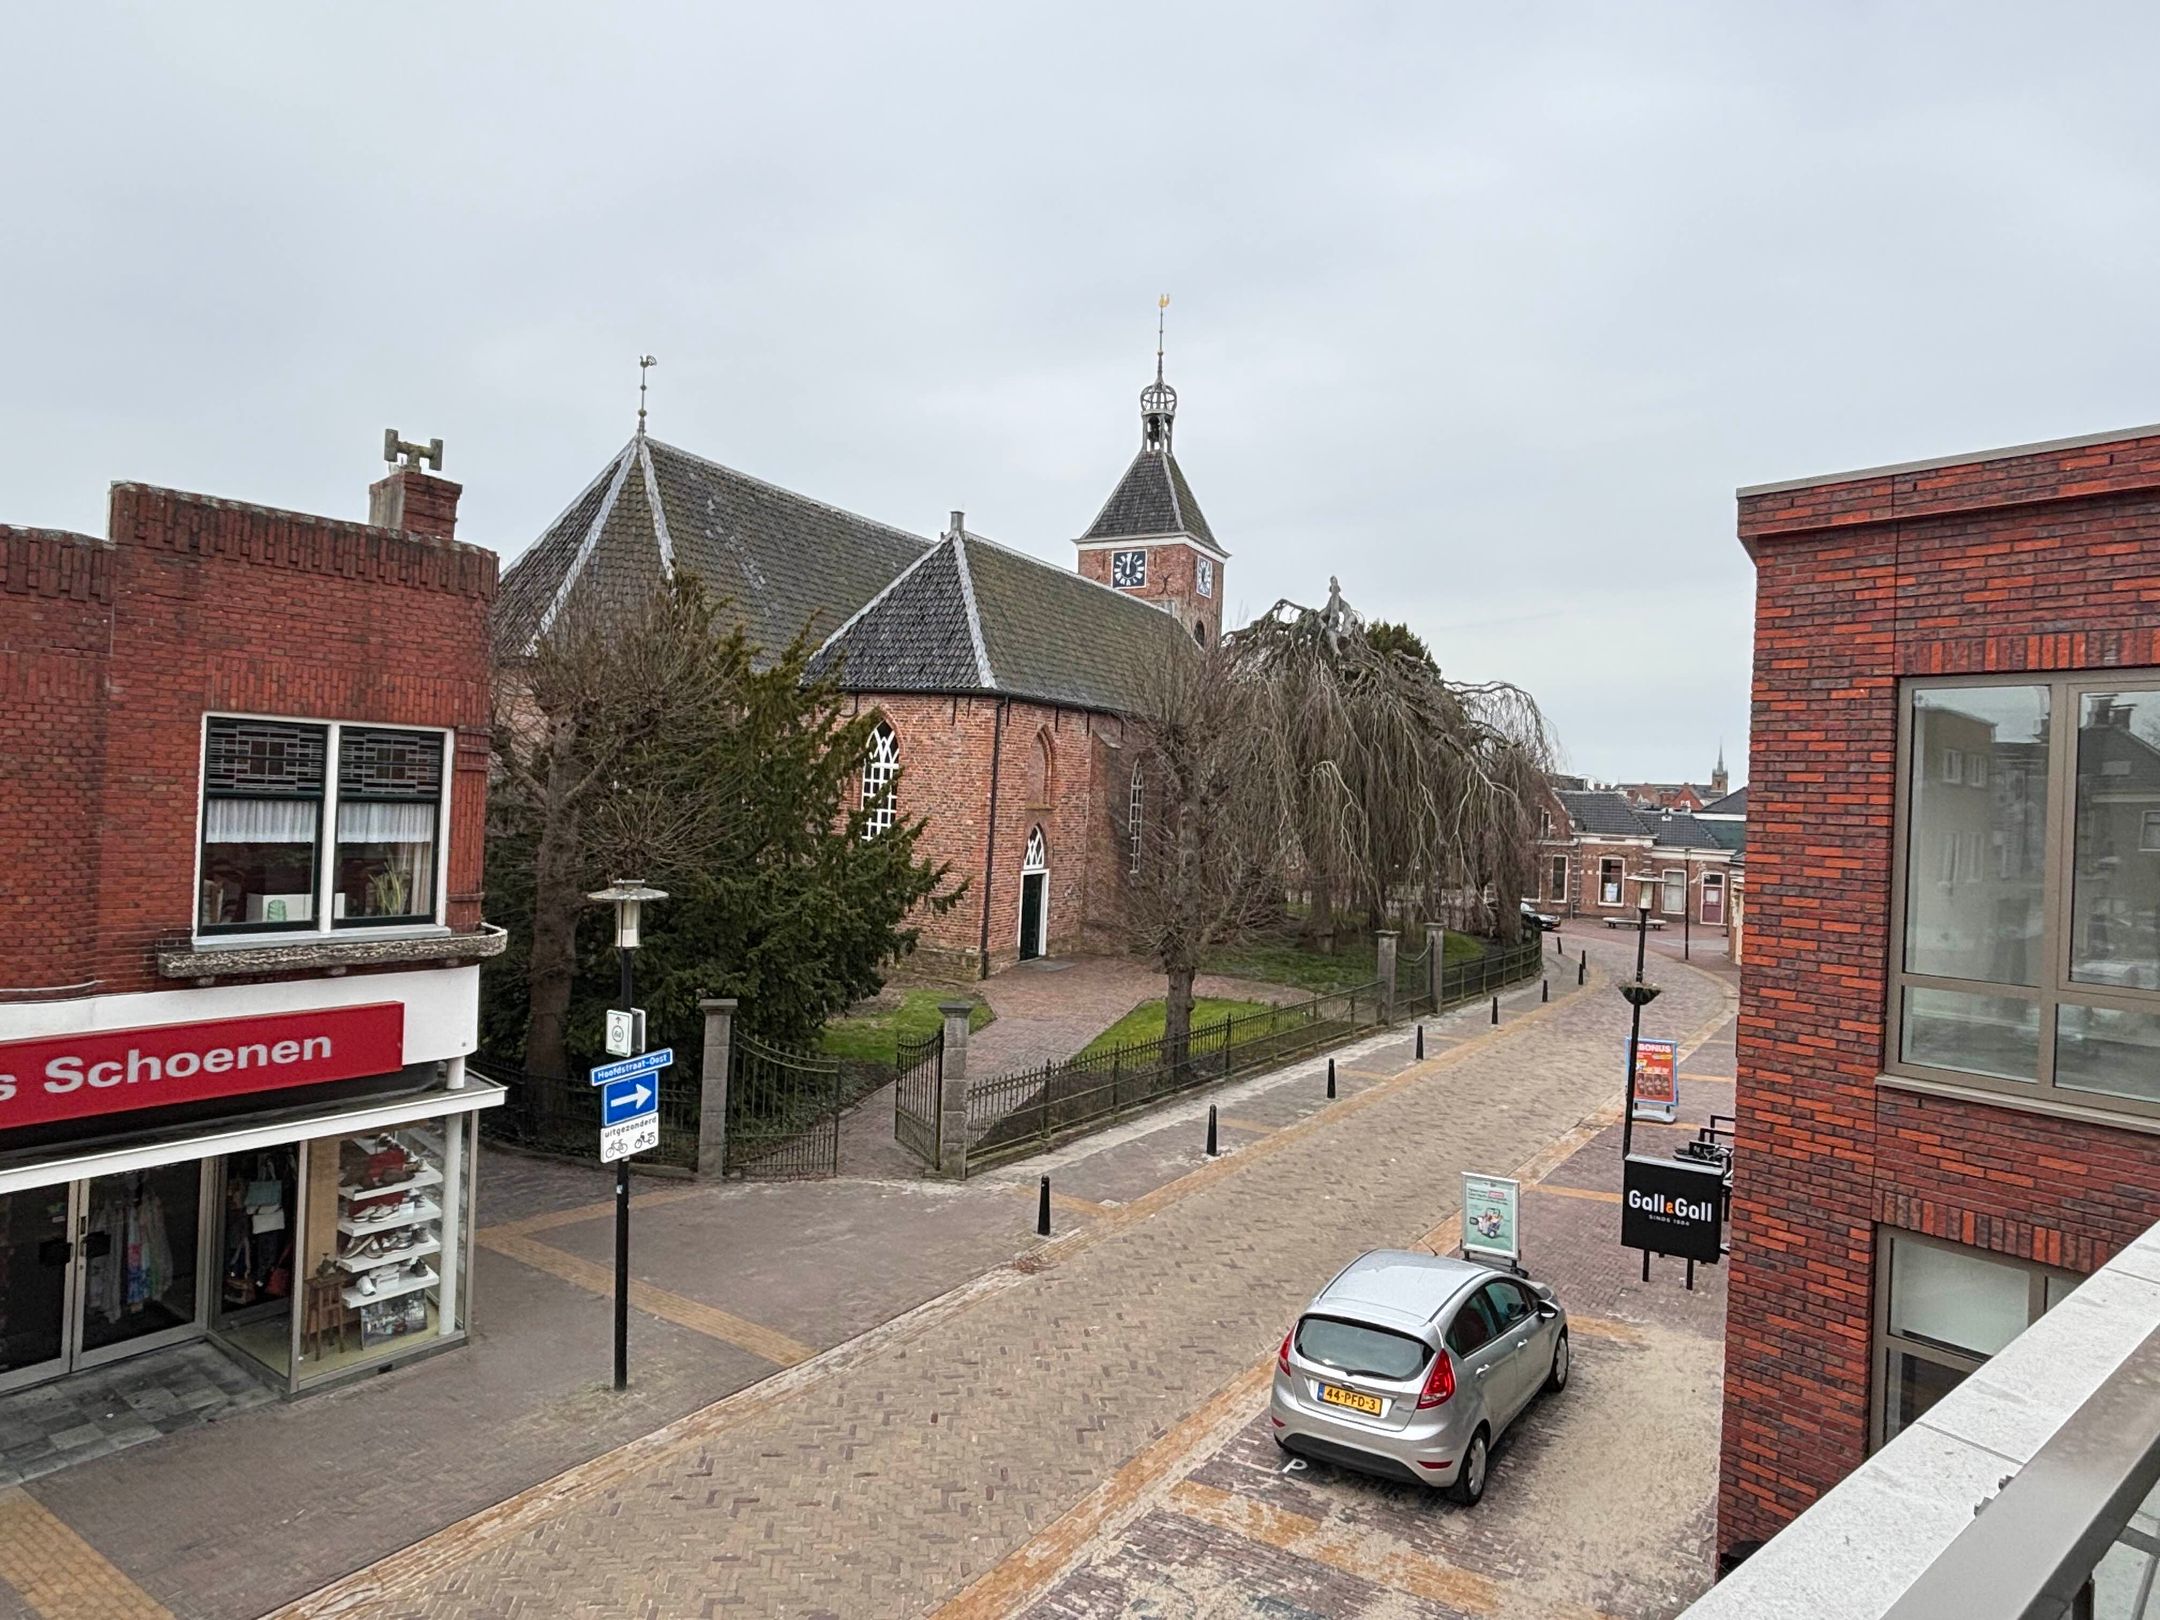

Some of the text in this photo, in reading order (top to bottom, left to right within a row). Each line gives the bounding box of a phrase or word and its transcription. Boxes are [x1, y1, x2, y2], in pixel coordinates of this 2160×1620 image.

[1638, 1043, 1671, 1053] BONUS
[43, 1036, 332, 1094] Schoenen
[597, 1053, 667, 1080] Hoofdstraat-Oost
[604, 1116, 657, 1138] uitgezonderd
[1326, 1388, 1376, 1411] 44-PFD-3
